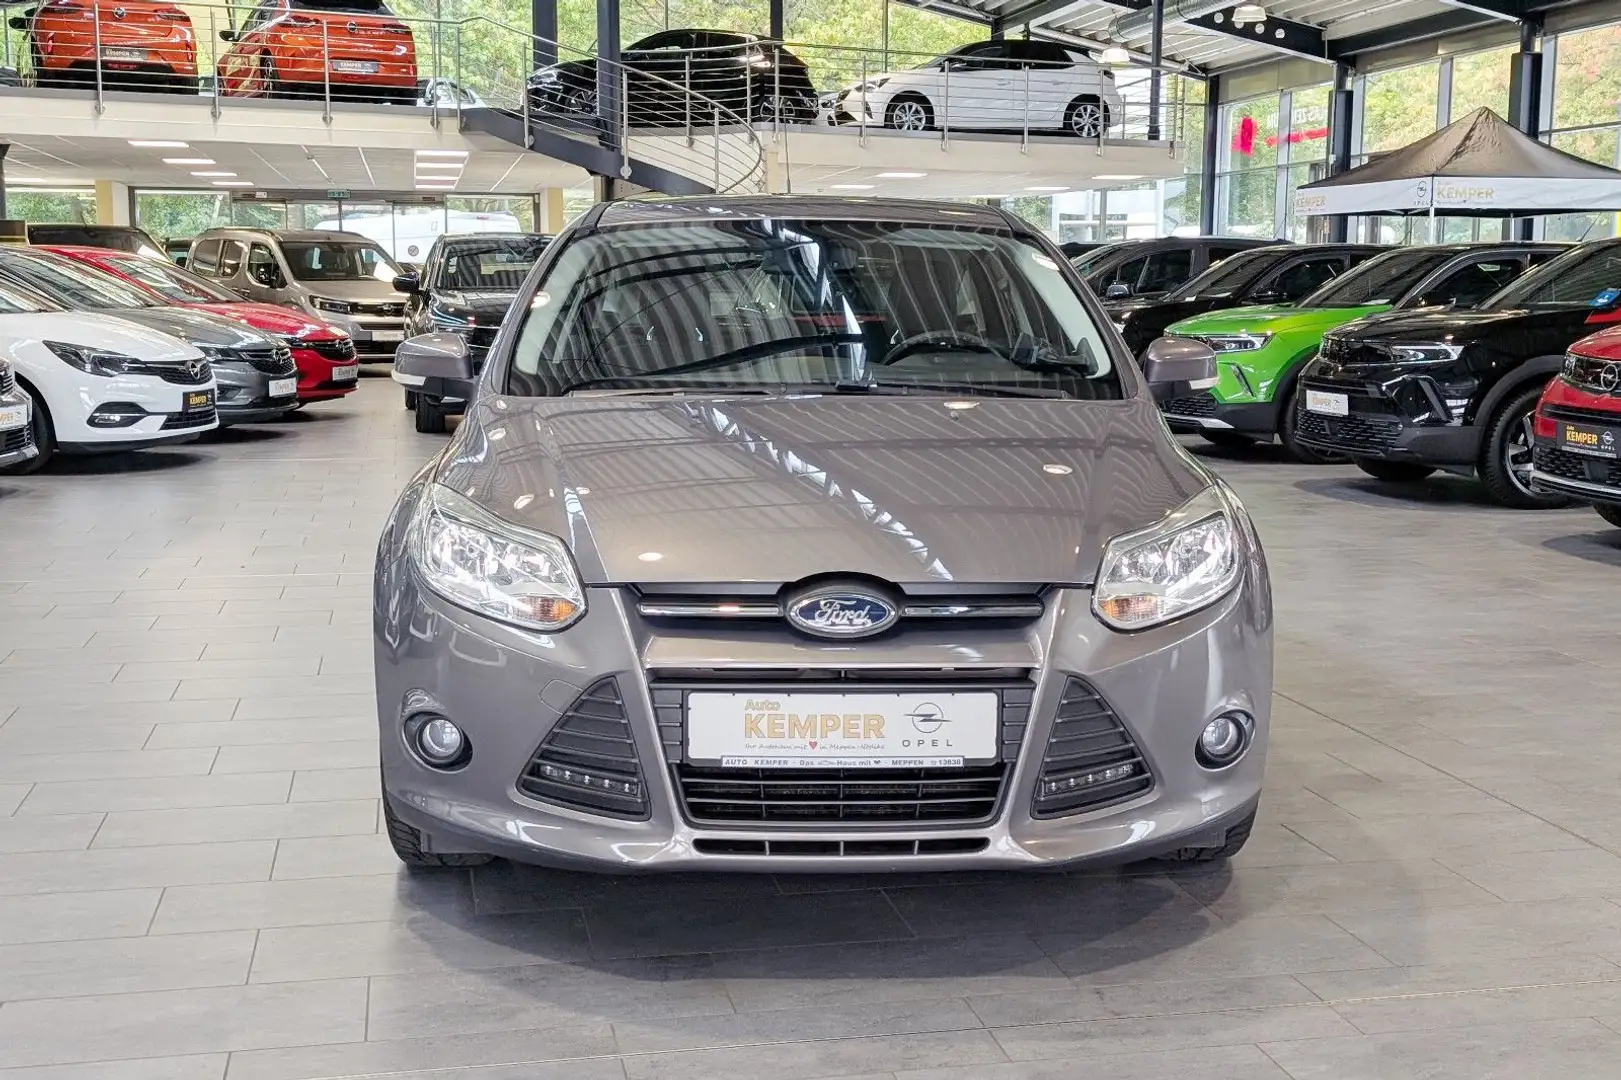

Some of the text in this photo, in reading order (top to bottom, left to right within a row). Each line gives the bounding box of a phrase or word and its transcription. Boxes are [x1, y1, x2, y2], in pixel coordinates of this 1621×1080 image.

[1437, 185, 1495, 199] KEMPER
[1566, 430, 1598, 445] KEMPER
[809, 599, 873, 625] Ford
[744, 699, 781, 711] Auto
[744, 713, 886, 738] KEMPER
[902, 739, 953, 748] OPEL
